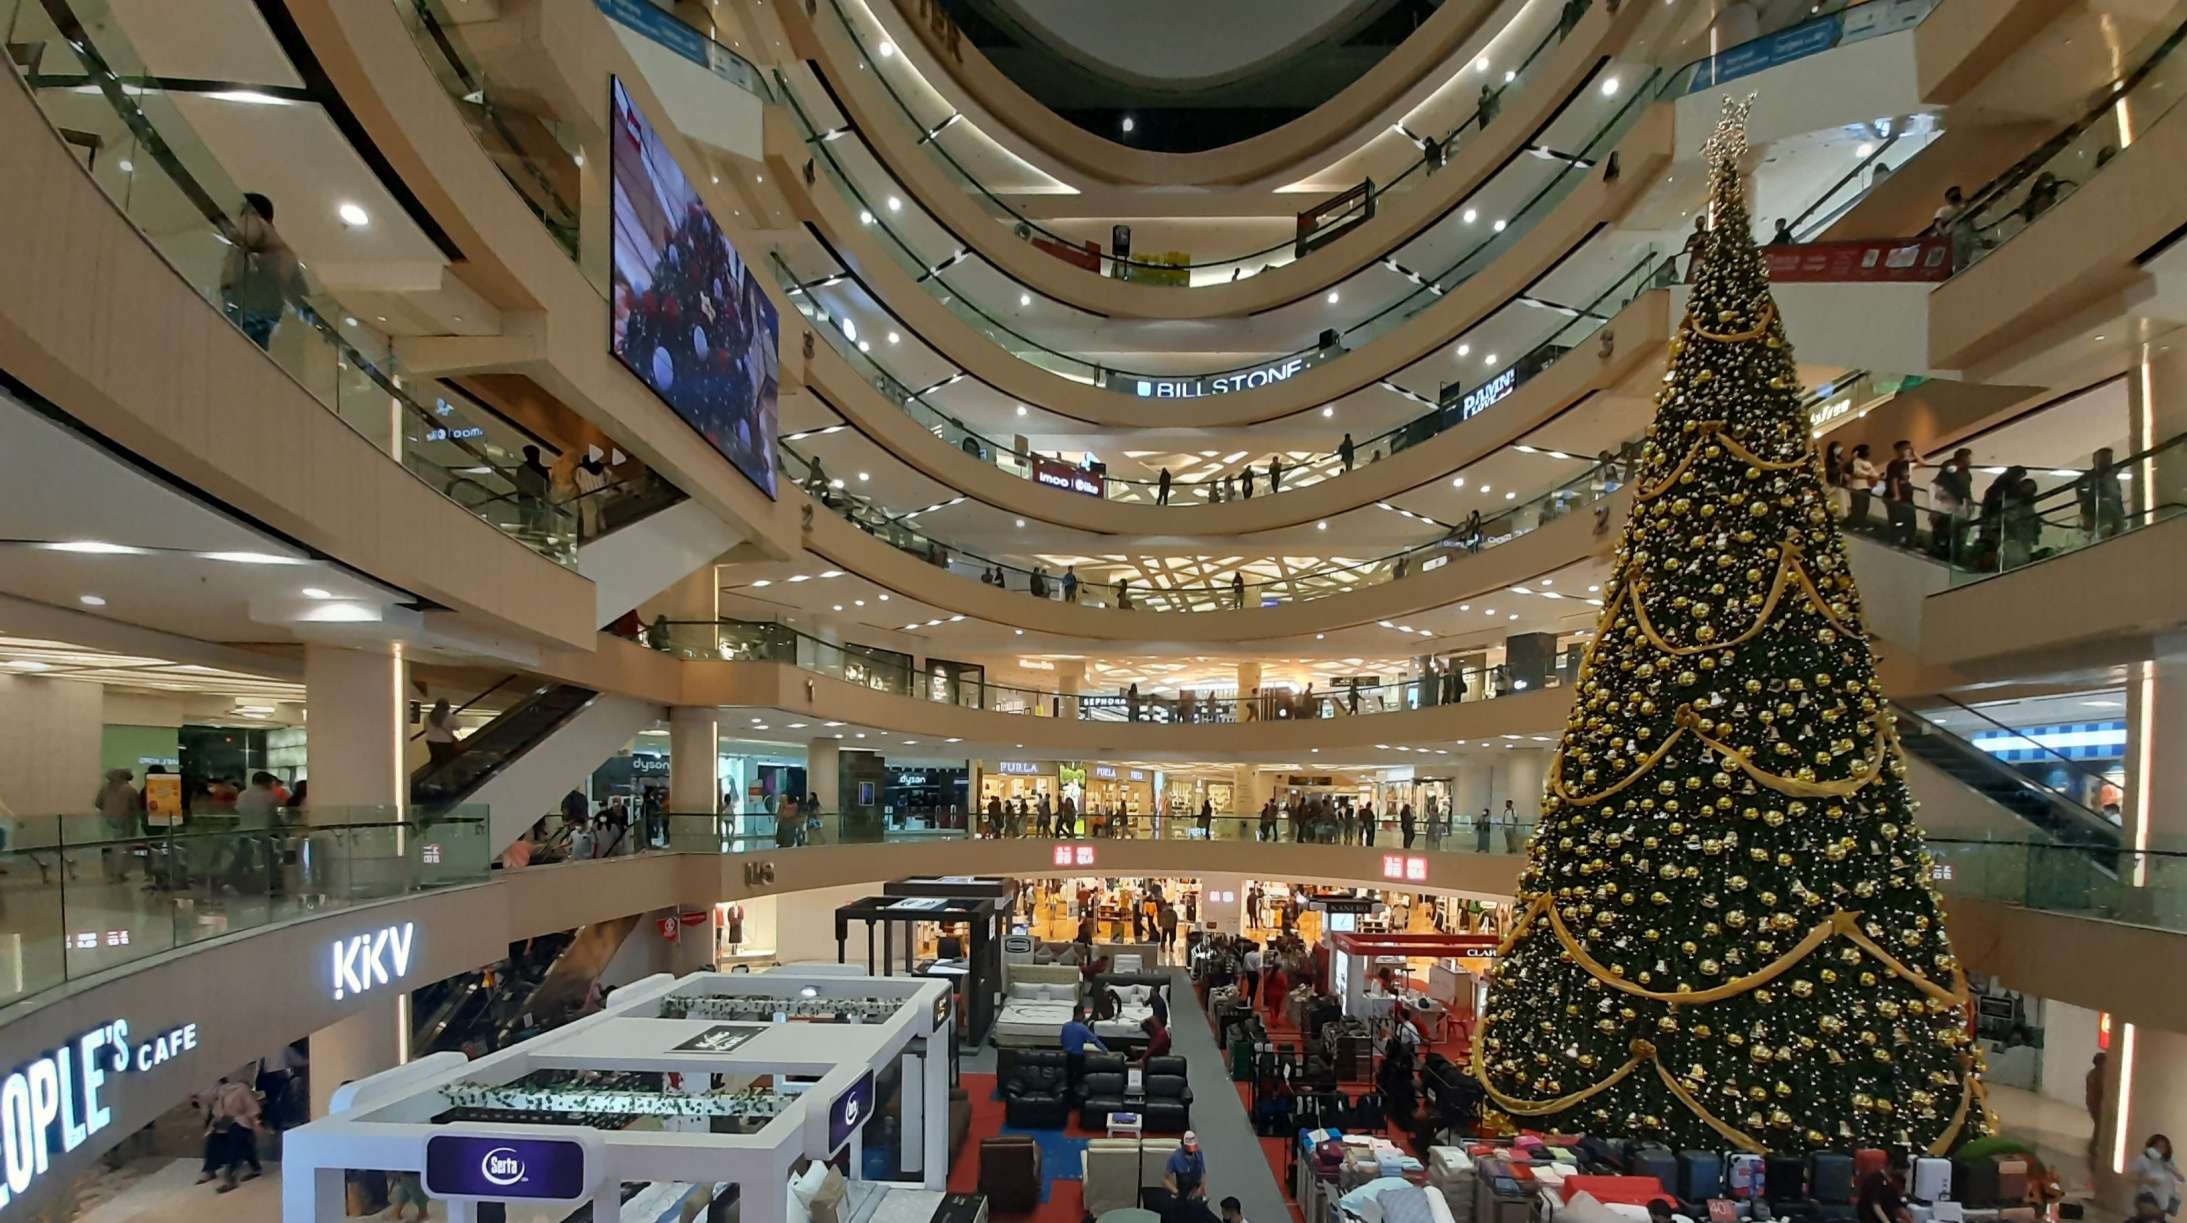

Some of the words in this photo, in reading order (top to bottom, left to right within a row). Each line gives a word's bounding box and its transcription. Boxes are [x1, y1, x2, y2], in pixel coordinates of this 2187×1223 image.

[1083, 698, 1126, 707] SEPHORA
[633, 758, 670, 772] dyson
[1000, 761, 1039, 773] FURLA
[900, 774, 926, 786] dyson
[0, 1019, 130, 1210] OPLE'S
[138, 1023, 197, 1071] CAFE
[490, 1155, 518, 1175] Serta
